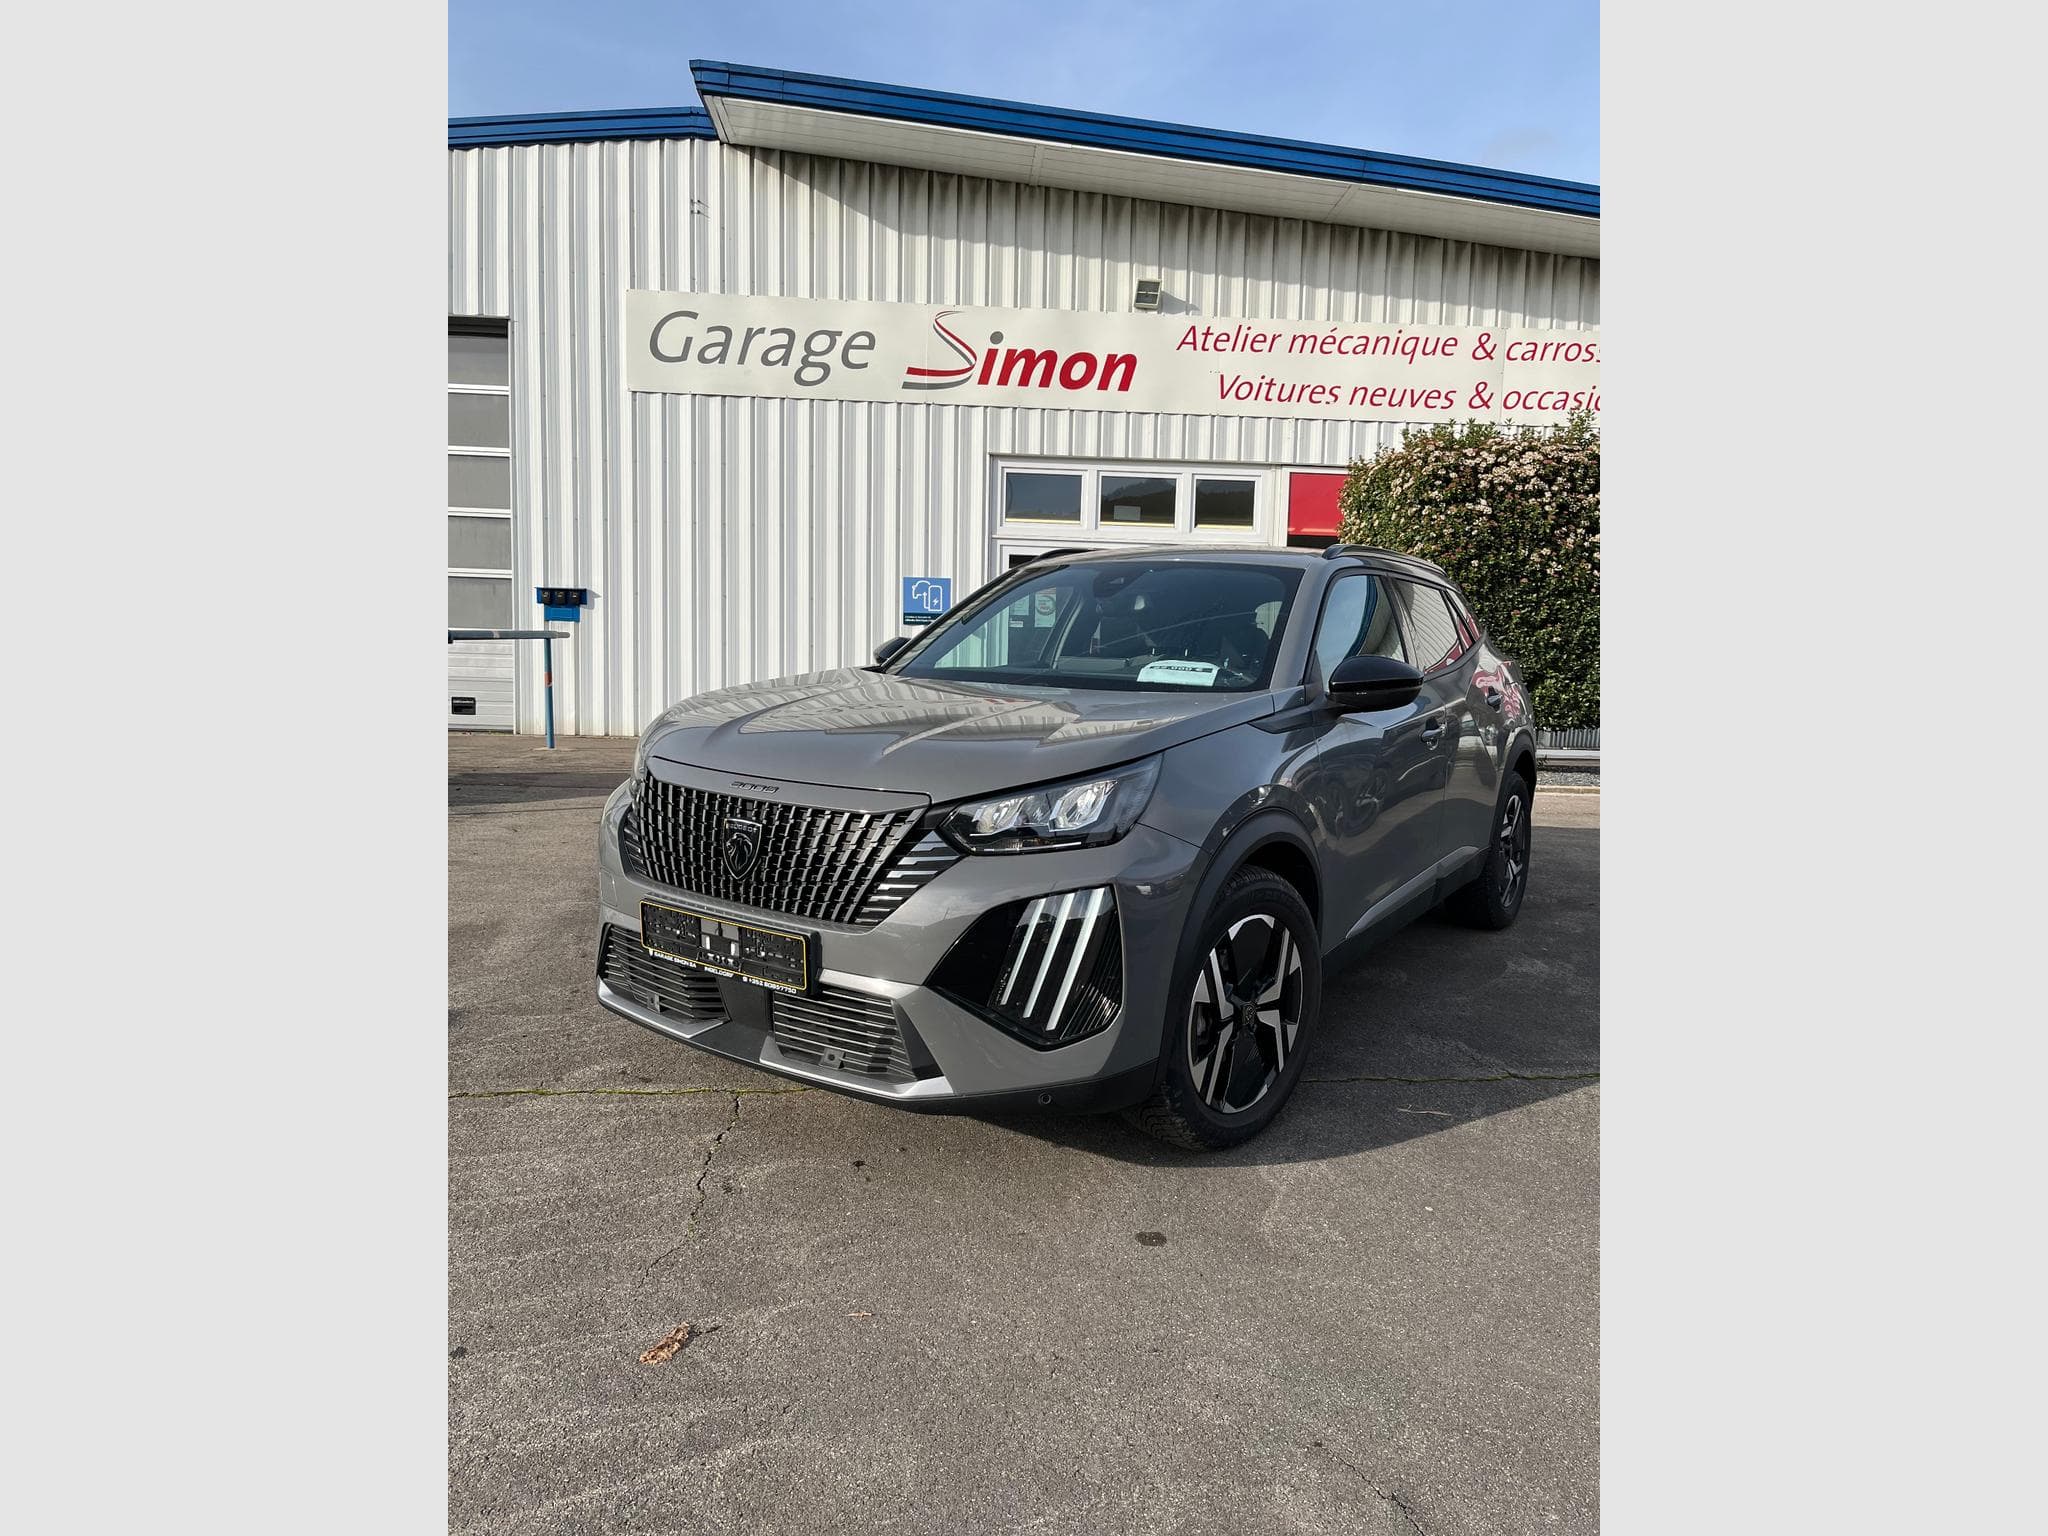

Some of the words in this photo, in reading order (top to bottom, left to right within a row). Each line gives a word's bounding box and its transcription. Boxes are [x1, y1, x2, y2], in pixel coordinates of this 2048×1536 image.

[649, 310, 876, 387] Garage
[901, 310, 1138, 393] Simon
[1176, 325, 1282, 352] Atelier
[1288, 327, 1458, 365] mécanique
[1471, 332, 1497, 361] &
[1505, 341, 1600, 363] carros
[1219, 374, 1341, 405] Voitures
[1348, 385, 1457, 411] neuves
[1467, 381, 1494, 410] &
